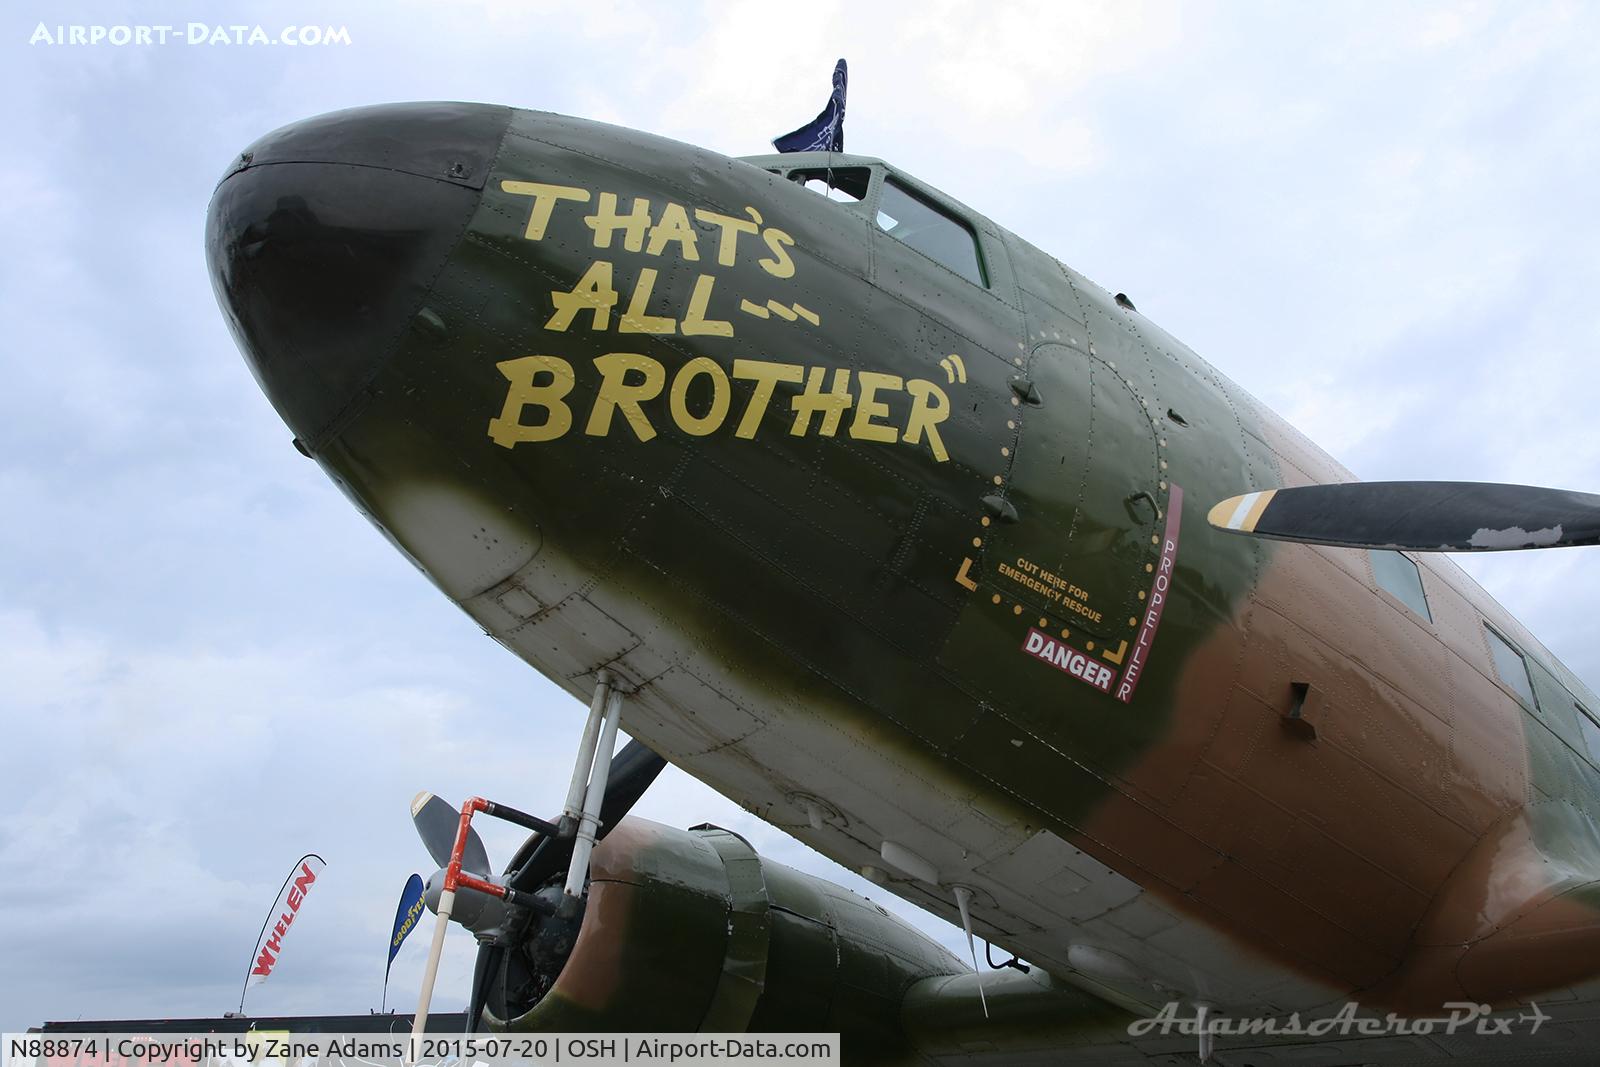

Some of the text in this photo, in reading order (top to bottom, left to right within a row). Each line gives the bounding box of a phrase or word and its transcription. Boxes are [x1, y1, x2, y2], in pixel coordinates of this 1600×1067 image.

[501, 181, 796, 279] THAT'S
[998, 563, 1102, 623] EMERGENCY RESCUE
[1017, 558, 1089, 602] CUT HERE FOR
[1118, 539, 1175, 701] PROPELLER
[1025, 631, 1113, 690] DANGER
[251, 862, 316, 976] WHELEN
[394, 891, 426, 946] GOODYEA
